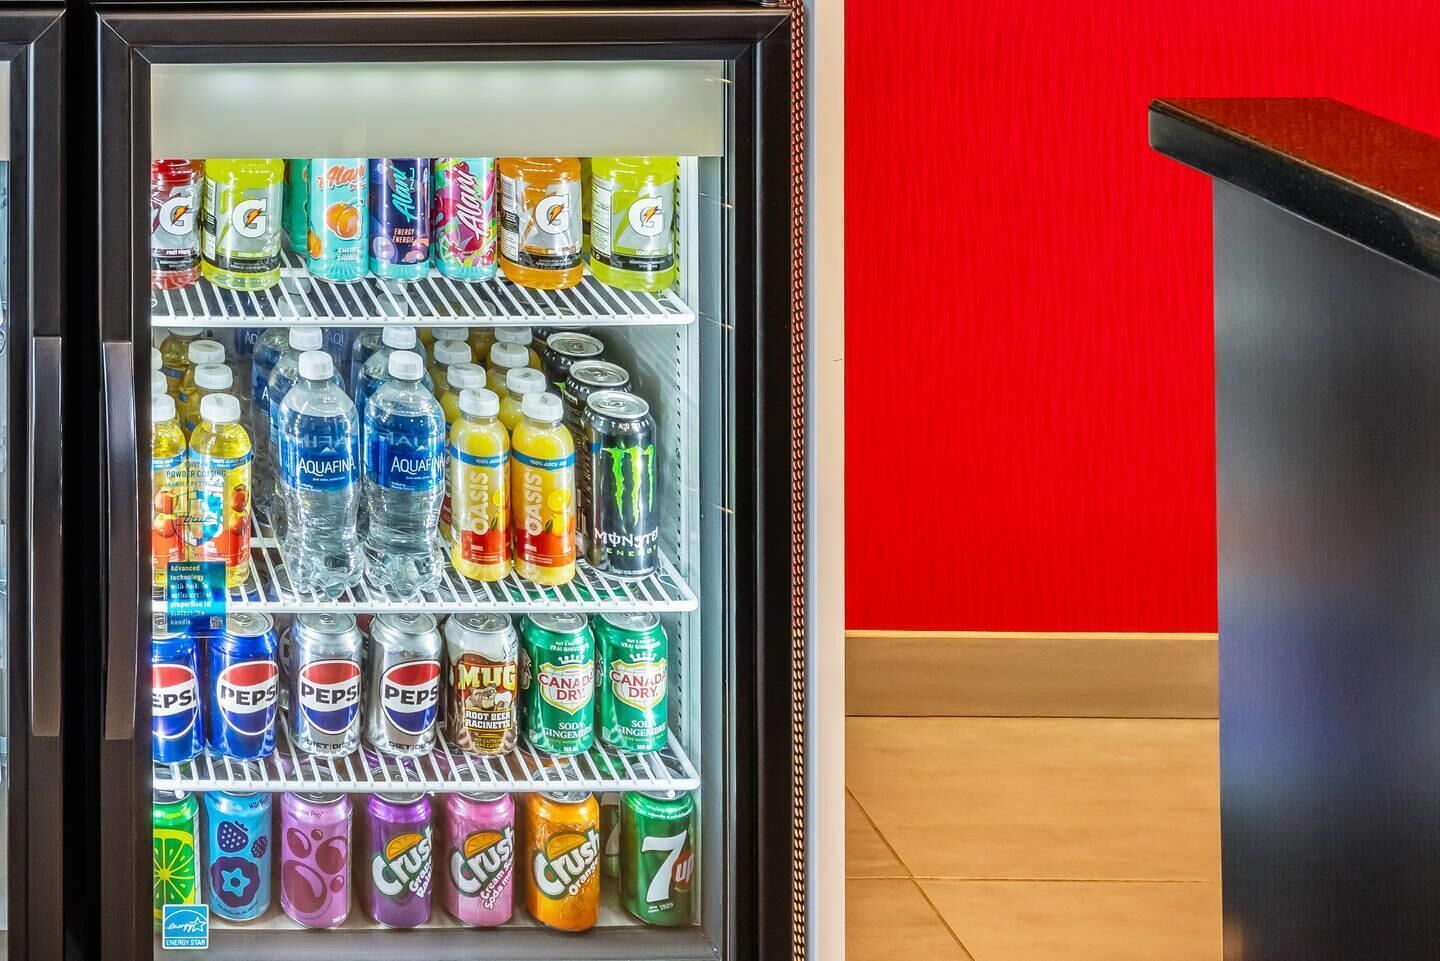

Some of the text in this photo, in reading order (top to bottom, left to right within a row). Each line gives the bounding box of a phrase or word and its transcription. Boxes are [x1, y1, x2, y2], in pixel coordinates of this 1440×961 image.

[389, 165, 418, 223] Alani
[455, 166, 486, 240] Alani
[394, 227, 415, 236] ENERGY
[166, 470, 195, 478] POWDER
[298, 457, 357, 478] AQUAFINA
[390, 455, 446, 476] AQUAFINA
[469, 472, 489, 536] OASIS
[524, 471, 544, 537] OASIS
[458, 664, 517, 691] MUG
[537, 672, 595, 690] CANADA
[610, 670, 667, 687] CANADA
[465, 711, 511, 722] ROOT BEER
[559, 722, 585, 730] SODA
[480, 869, 505, 901] Cream
[484, 885, 504, 910] Soda
